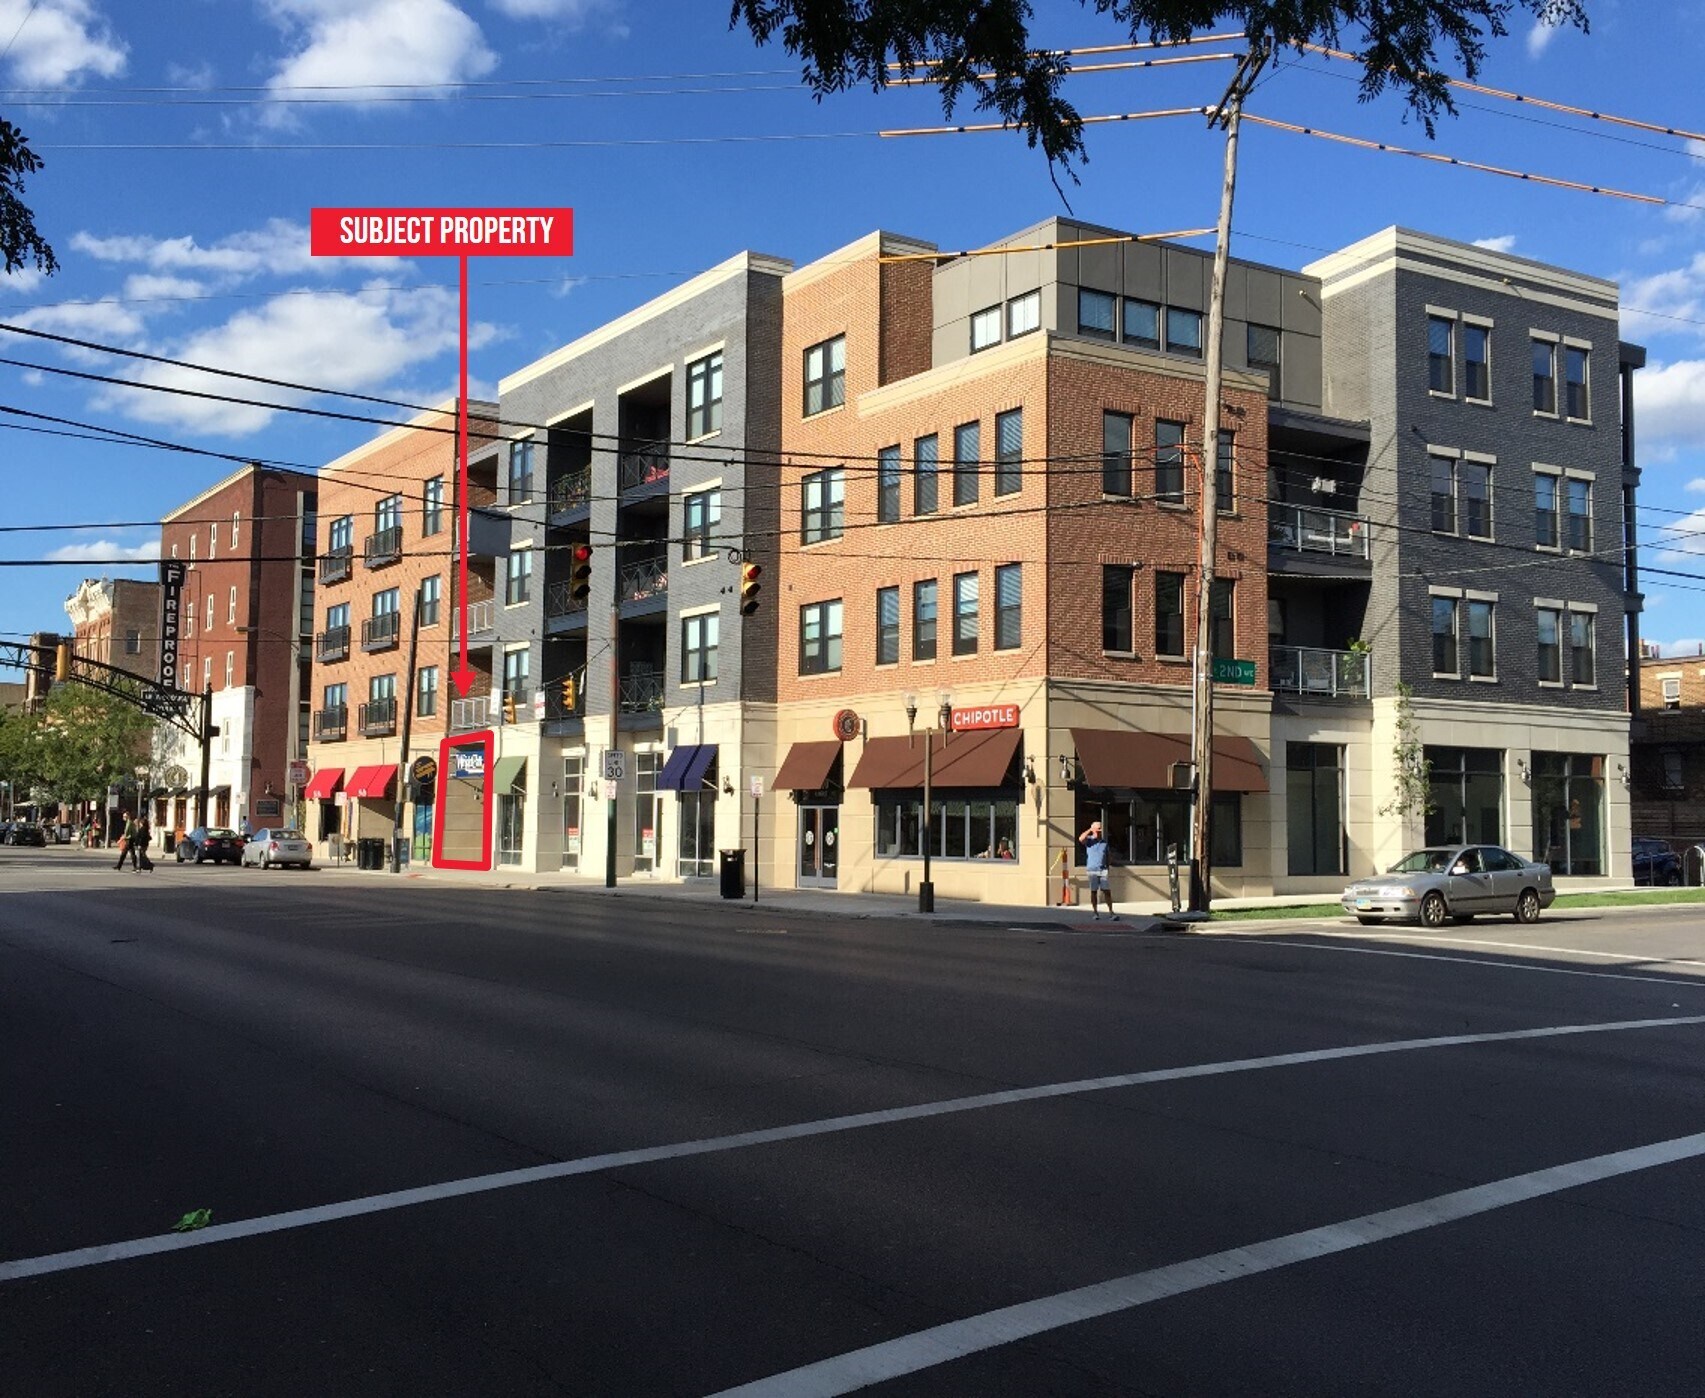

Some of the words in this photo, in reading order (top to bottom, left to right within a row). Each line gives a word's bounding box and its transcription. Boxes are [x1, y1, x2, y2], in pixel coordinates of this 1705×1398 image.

[163, 569, 181, 687] FIREPROOF
[1219, 664, 1242, 678] 2ND
[953, 707, 1014, 726] CHIPOTLE
[607, 766, 624, 778] 30
